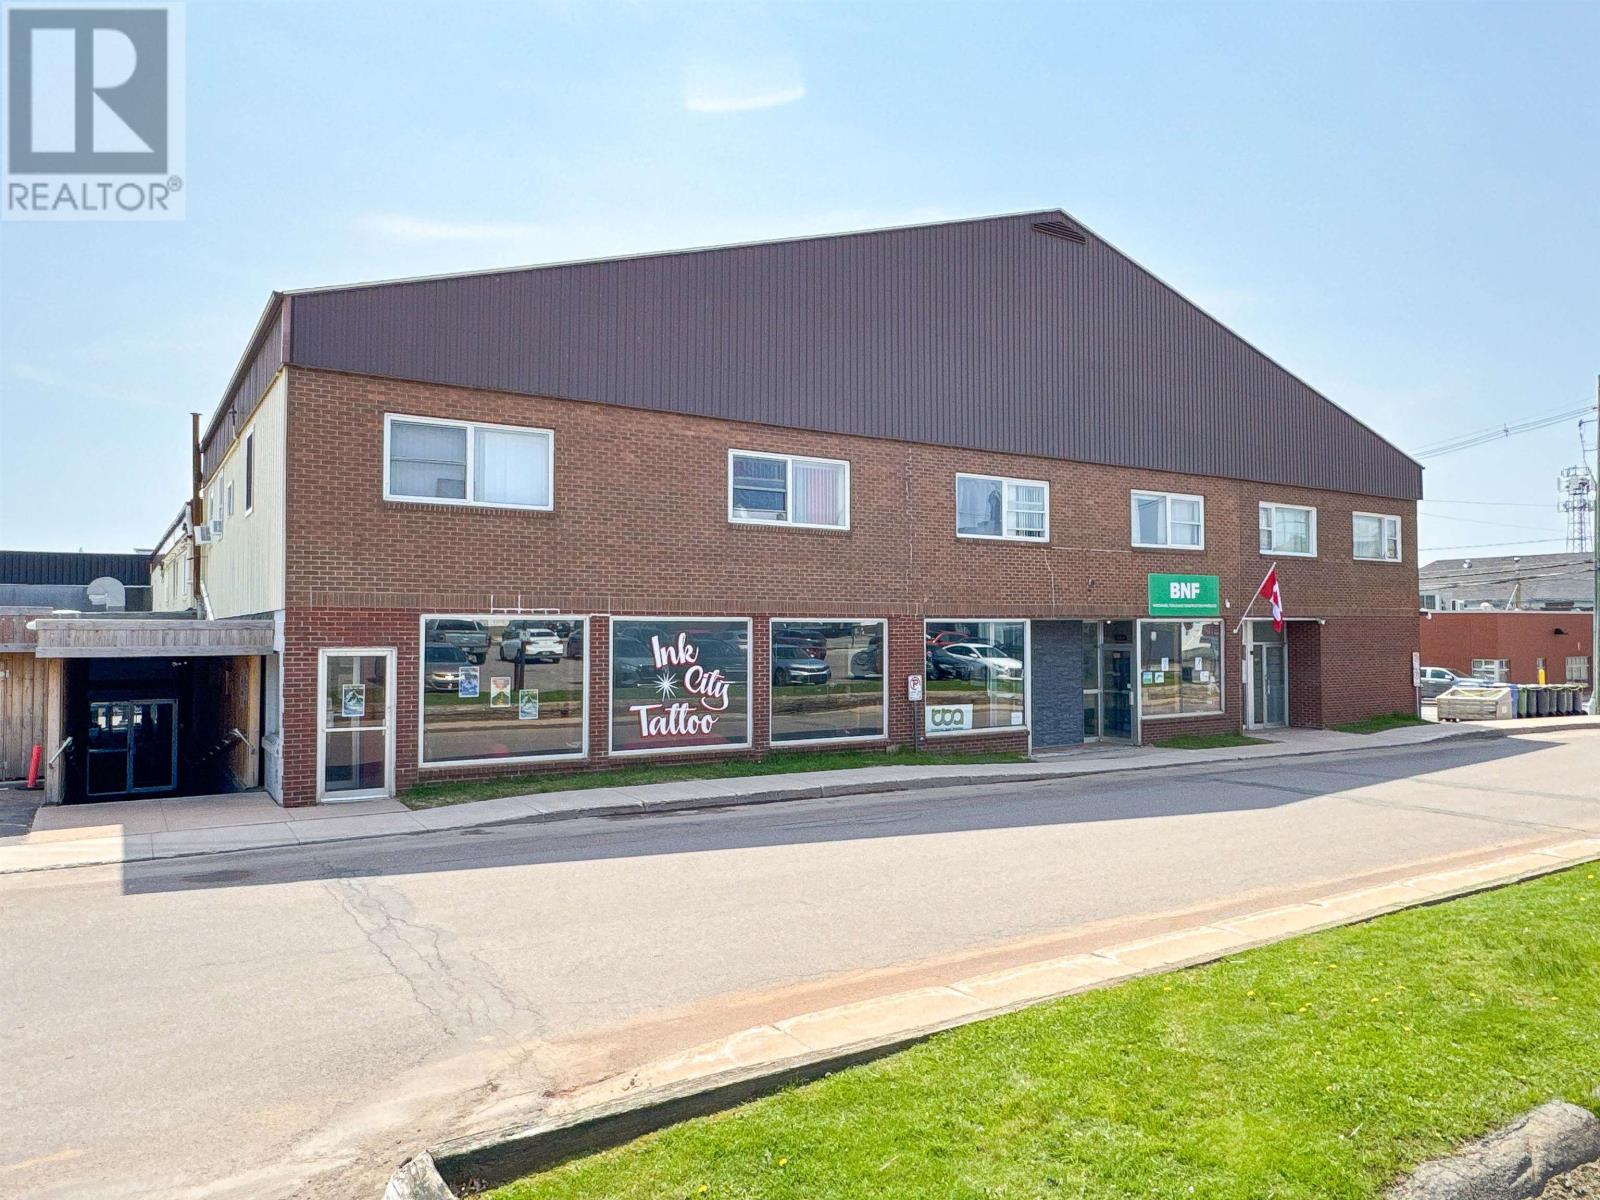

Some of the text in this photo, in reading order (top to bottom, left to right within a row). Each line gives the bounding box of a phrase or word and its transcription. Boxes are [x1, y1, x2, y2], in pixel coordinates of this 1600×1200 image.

[1169, 582, 1200, 599] BNF
[651, 632, 699, 668] Ink
[684, 665, 735, 711] City
[629, 703, 719, 736] Tattoo
